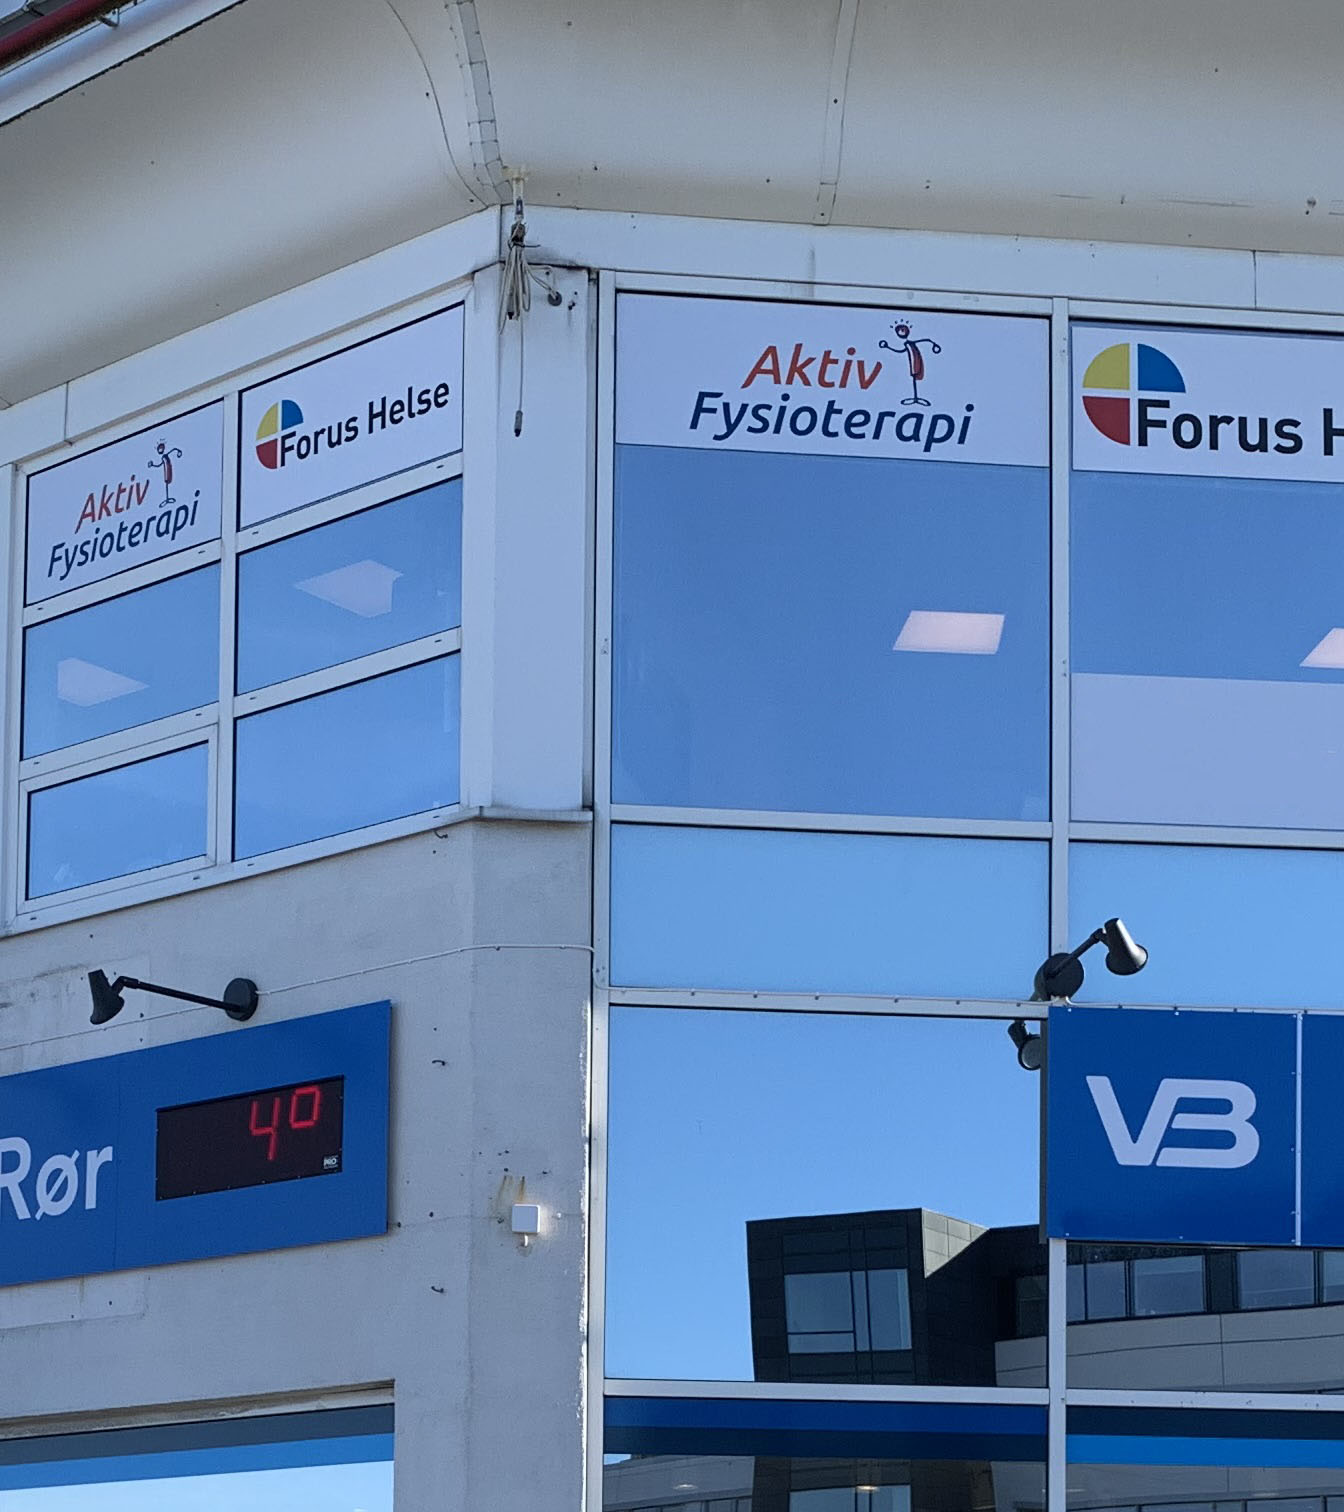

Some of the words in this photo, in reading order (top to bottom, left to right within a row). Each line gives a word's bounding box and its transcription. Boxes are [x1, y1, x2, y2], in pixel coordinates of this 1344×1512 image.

[741, 342, 882, 393] Aktiv
[280, 416, 358, 468] Forus
[367, 382, 451, 434] Helse
[689, 389, 975, 453] Fysioterapi
[1137, 399, 1303, 453] Forus
[47, 490, 201, 580] Fysioterapi
[75, 474, 150, 533] Aktiv
[1086, 1075, 1260, 1170] VB
